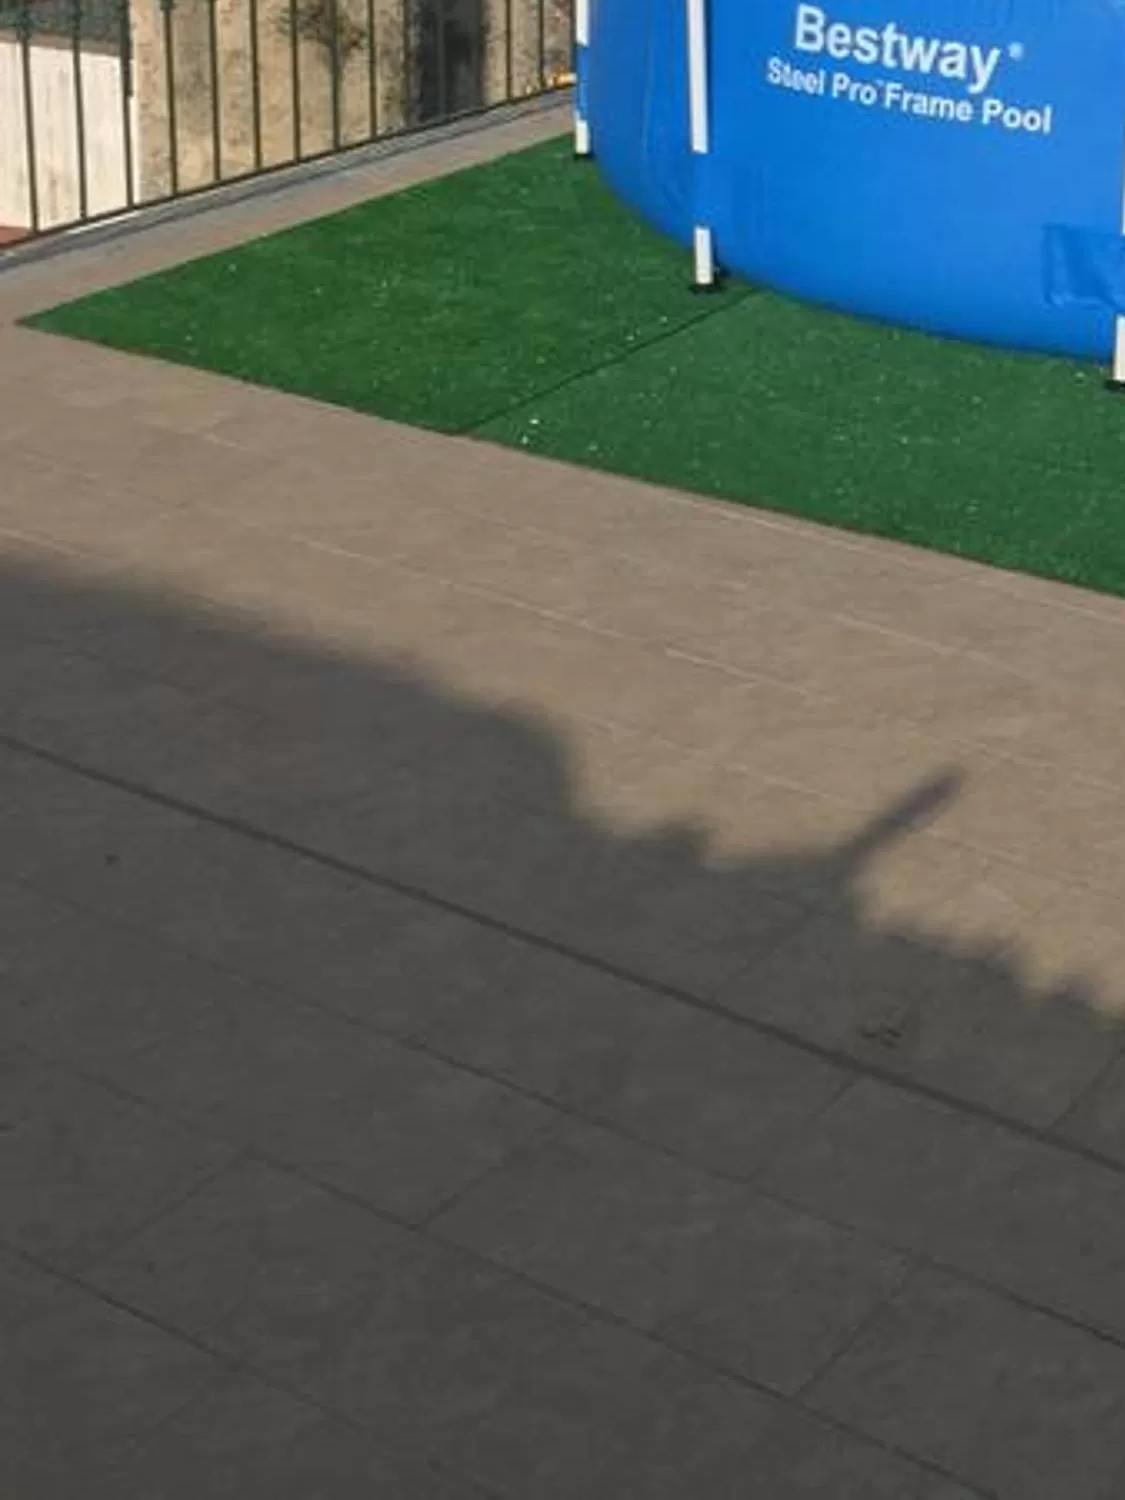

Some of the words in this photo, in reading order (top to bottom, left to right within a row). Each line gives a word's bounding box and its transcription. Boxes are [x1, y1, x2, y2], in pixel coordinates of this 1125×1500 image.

[766, 56, 825, 96] Steel
[884, 81, 973, 123] Frame
[981, 98, 1053, 135] Pool
